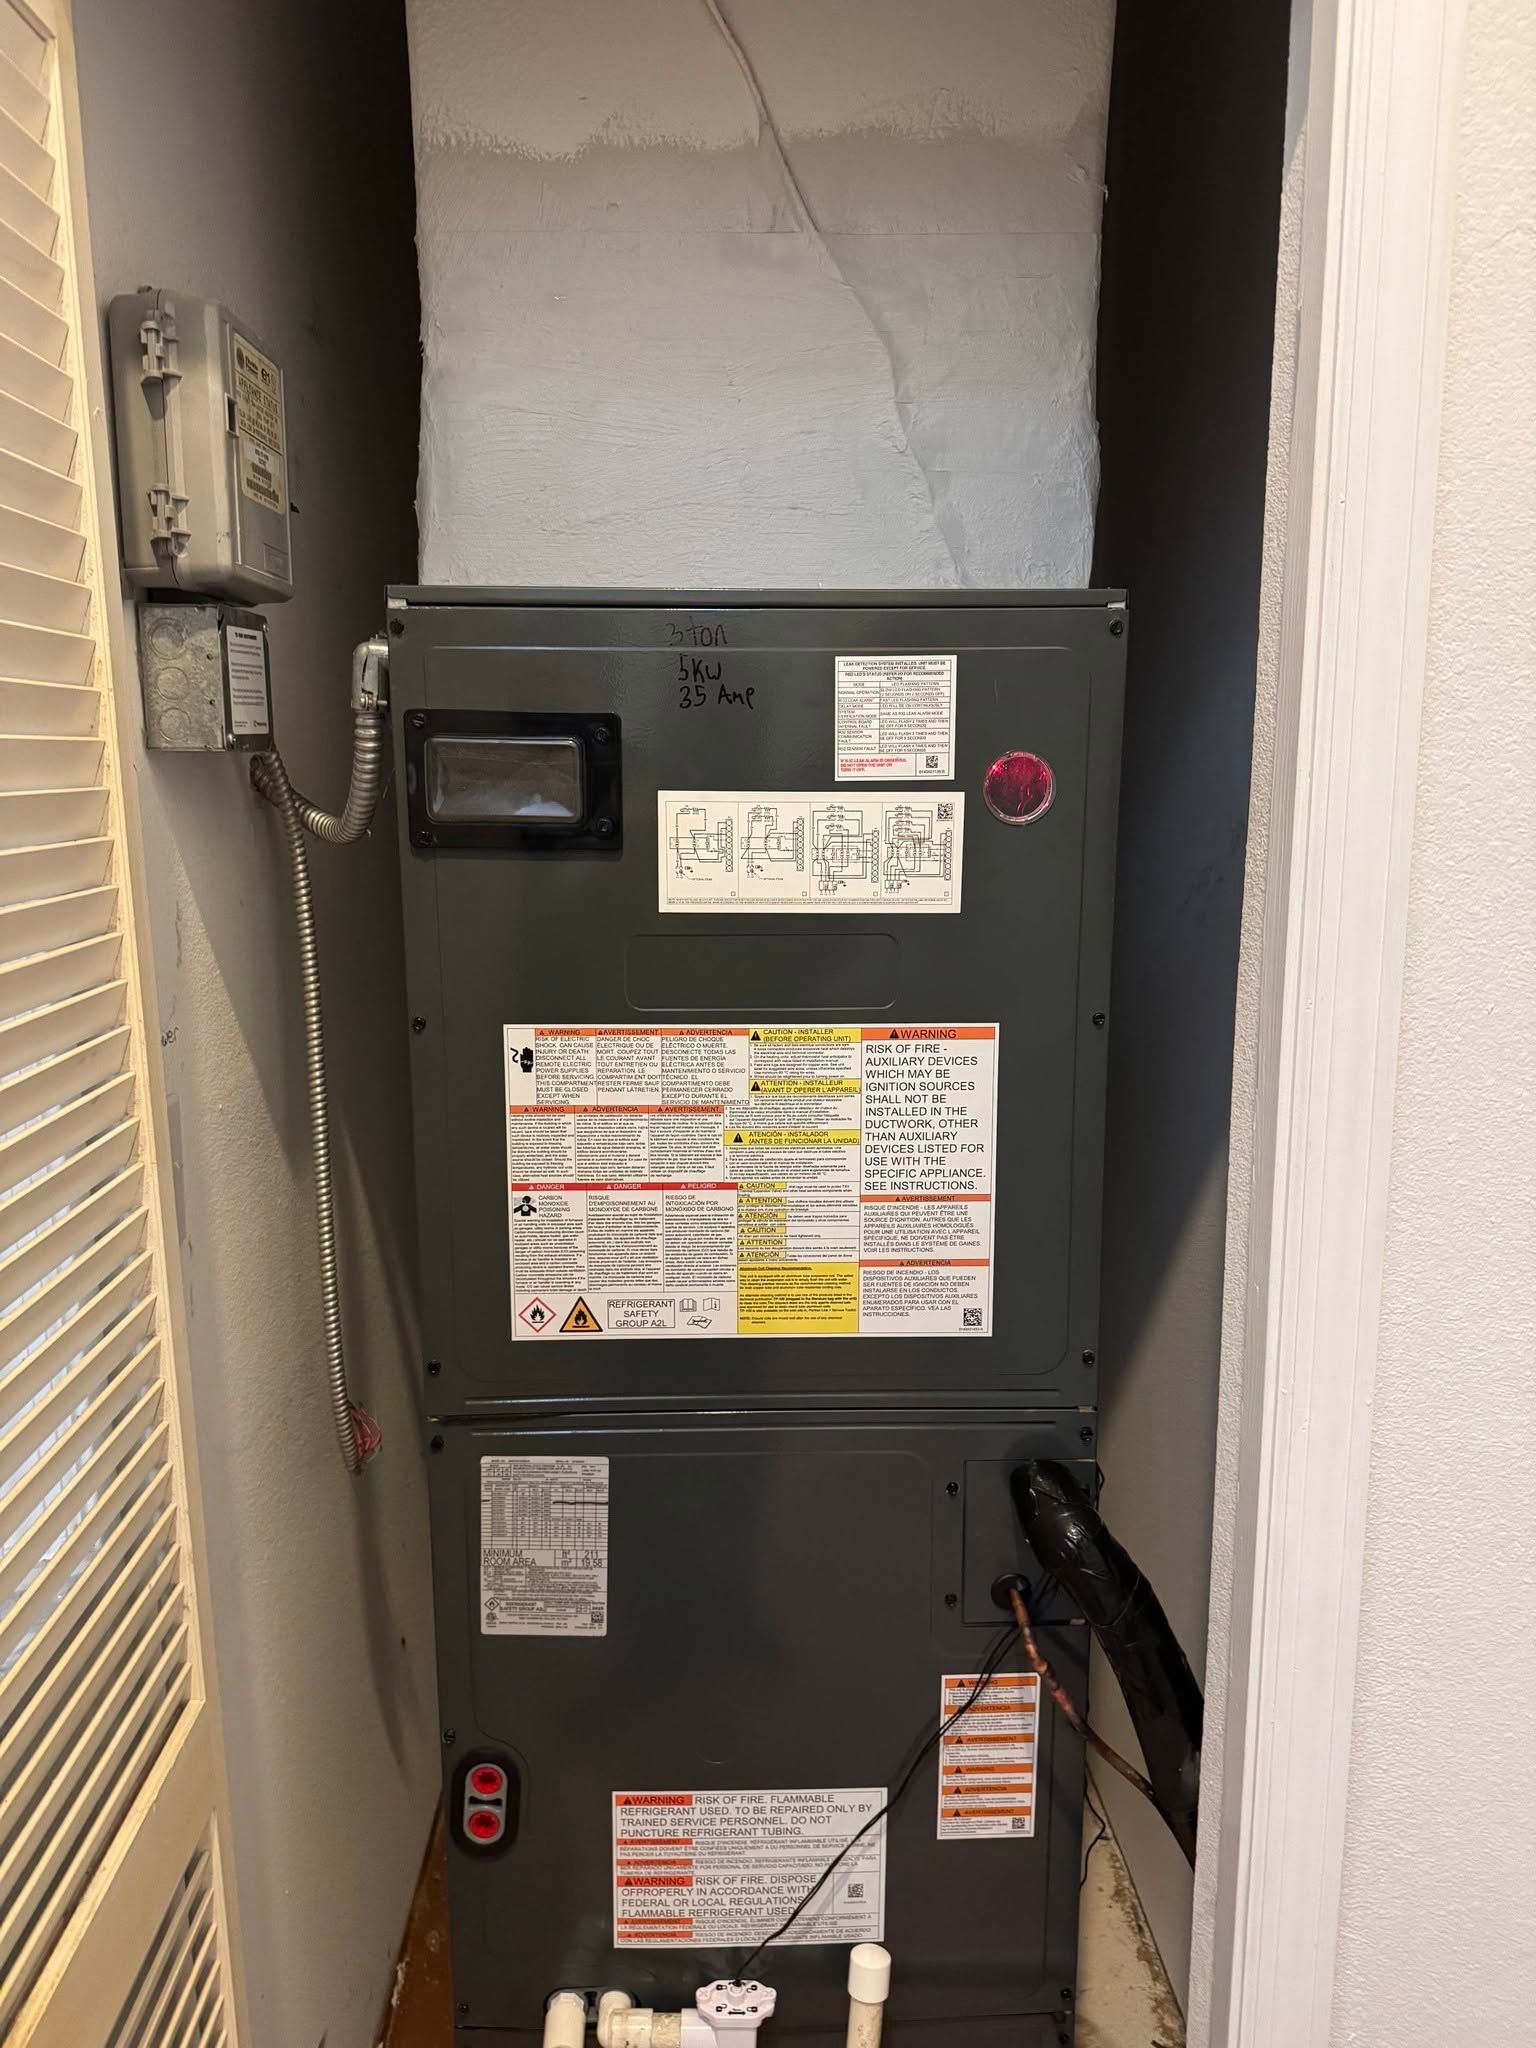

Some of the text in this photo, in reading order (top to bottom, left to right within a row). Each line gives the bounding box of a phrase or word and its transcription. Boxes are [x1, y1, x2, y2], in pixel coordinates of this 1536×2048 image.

[665, 622, 683, 647] 3
[680, 683, 706, 710] 35
[900, 1029, 956, 1039] WARNING
[866, 1044, 940, 1054] RISK OF FIRE
[866, 1057, 977, 1066] AUXILIARY DEVICES
[866, 1070, 950, 1079] WHICH MAY BE
[866, 1082, 975, 1091] IGNITION SOURCES
[866, 1095, 946, 1104] SHALL NOT BE
[866, 1107, 967, 1116] INSTALLED IN THE
[865, 1119, 978, 1129] DUCTWORK, OTHER
[749, 1137, 772, 1145] (ANTES
[774, 1137, 783, 1145] DE
[785, 1137, 822, 1145] FUNCIONAR
[824, 1137, 831, 1145] LA
[865, 1132, 957, 1141] THAN AUXILIARY
[865, 1144, 984, 1153] DEVICES LISTED FOR
[865, 1157, 946, 1166] USE WITH THE
[865, 1169, 985, 1178] SPECIFIC APPLIANCE.
[864, 1181, 977, 1190] SEE INSTRUCTIONS.
[624, 1310, 658, 1318] SAFETY
[632, 1796, 684, 1804] WARNING
[695, 1795, 834, 1804] RISK OF FIRE. FLAMMABLE
[621, 1806, 696, 1816] REFRIGERANT
[735, 1806, 750, 1814] TO
[753, 1806, 766, 1814] BE
[770, 1805, 824, 1814] REPAIRED
[827, 1805, 855, 1813] ONLY
[858, 1804, 871, 1813] BY
[621, 1815, 832, 1826] TRAINED SERVICE PERSONNEL. DO NOT
[621, 1827, 801, 1837] PUNCTURE REFRIGERANT TUBING.
[632, 1877, 684, 1885] WARNING
[696, 1875, 816, 1885] RISK OF FIRE. DISPOSE
[622, 1887, 693, 1896] OFPROPERLY
[697, 1887, 707, 1896] IN
[710, 1886, 784, 1895] ACCORDANCE
[622, 1897, 669, 1907] FEDERAL
[673, 1897, 689, 1906] OR
[692, 1897, 726, 1906] LOCAL
[622, 1908, 685, 1918] FLAMMABLE
[688, 1908, 763, 1917] REFRIGERANT
